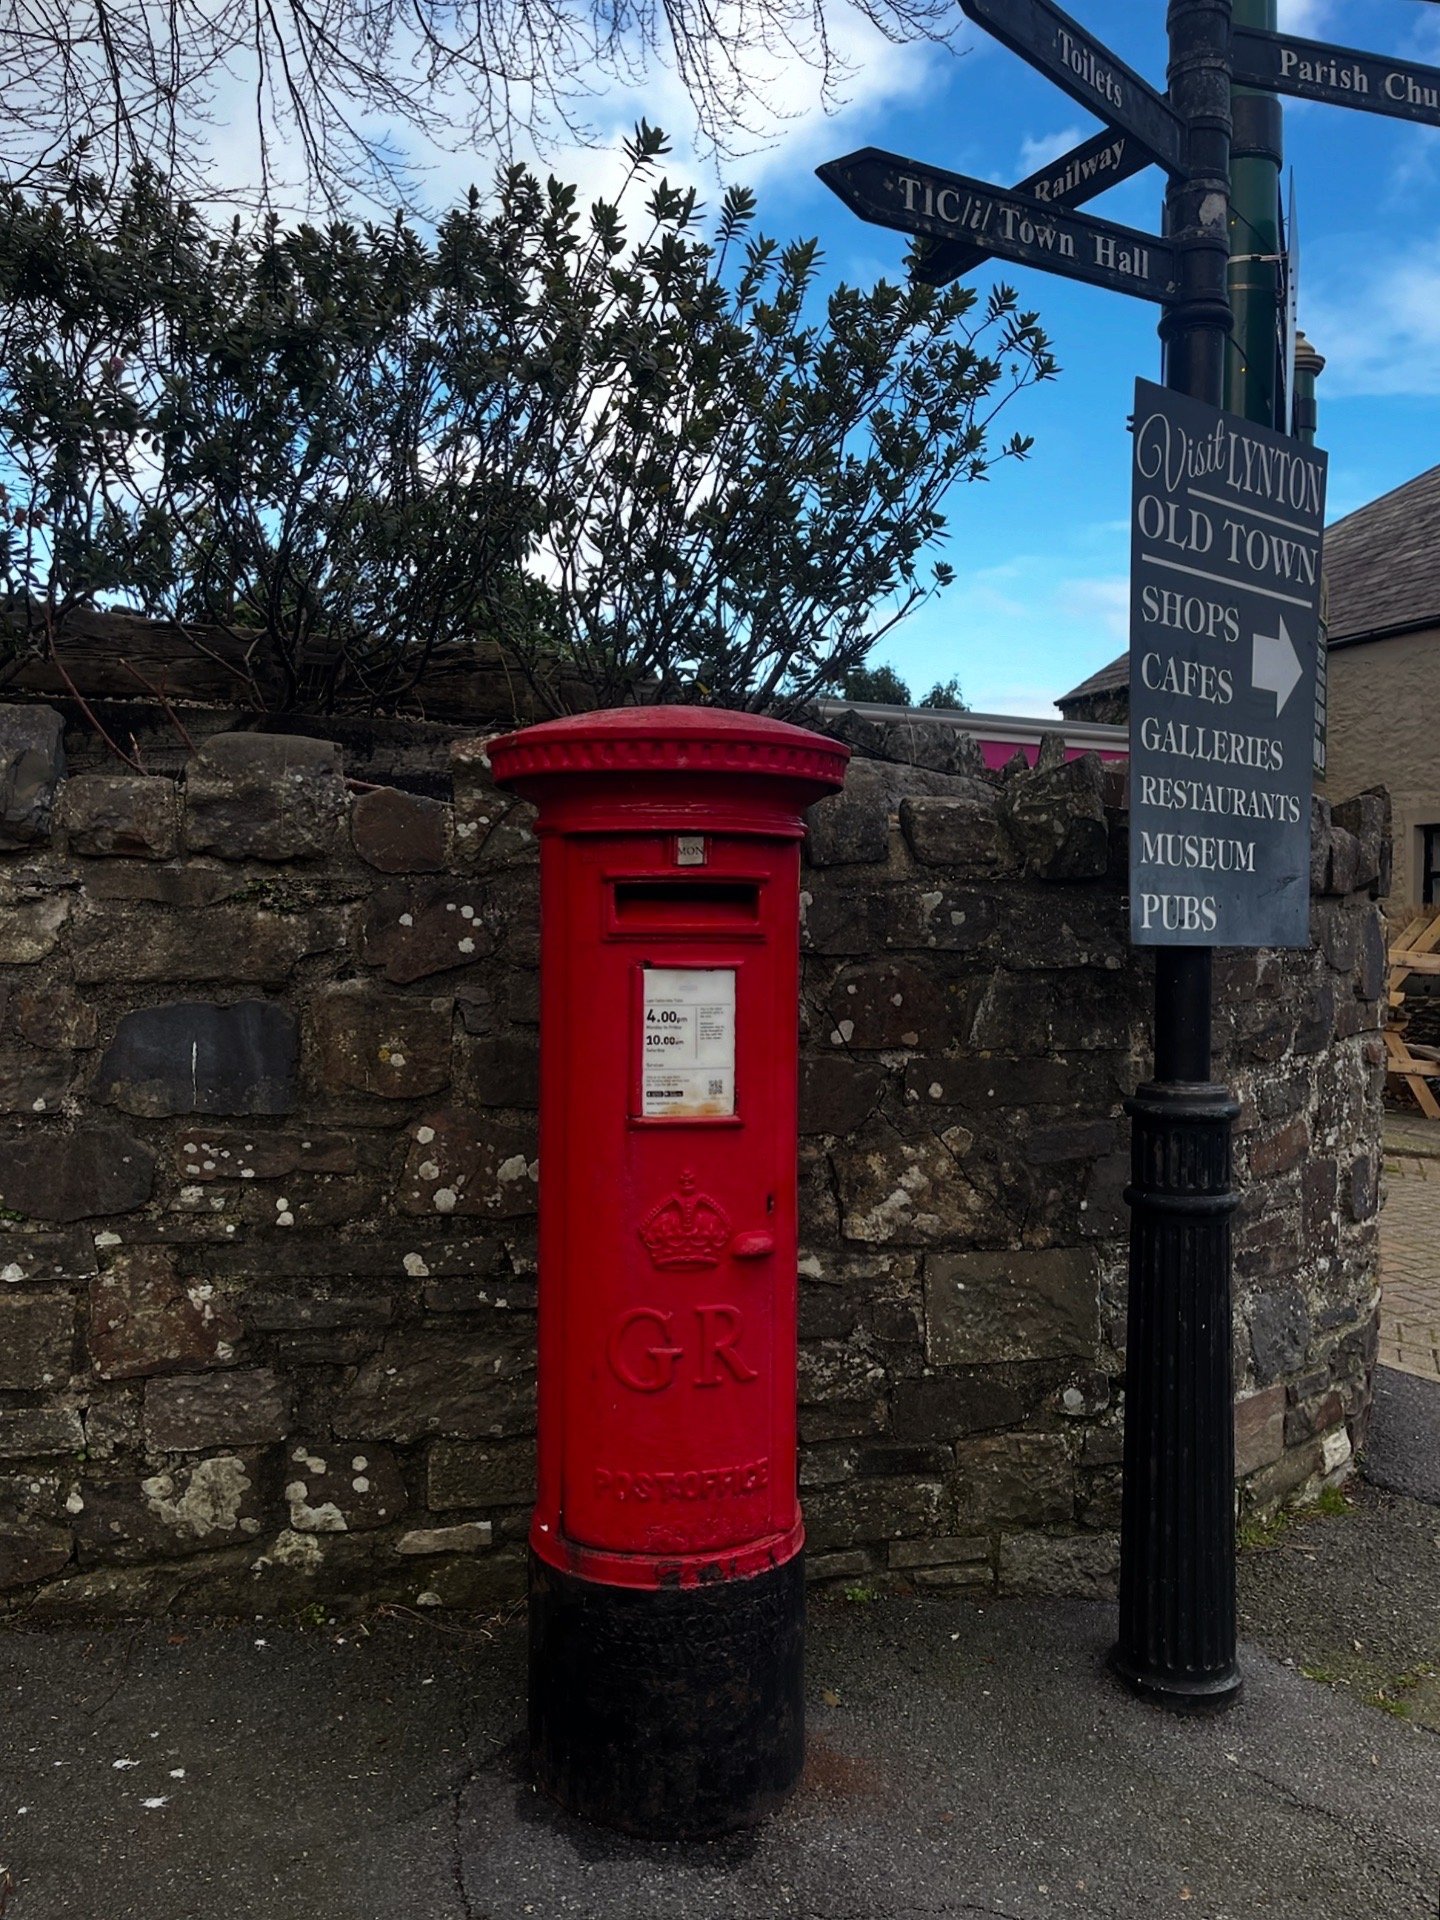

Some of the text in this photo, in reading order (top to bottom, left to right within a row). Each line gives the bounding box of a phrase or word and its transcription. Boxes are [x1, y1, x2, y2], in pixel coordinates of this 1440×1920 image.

[1056, 29, 1123, 109] Toilets
[1278, 49, 1369, 94] Parish
[1034, 138, 1127, 202] Railway
[998, 206, 1076, 258] Town
[1093, 235, 1150, 280] Hall
[1136, 413, 1324, 517] Visit LYNTON
[1137, 494, 1319, 587] OLD TOWN
[1141, 584, 1240, 643] SHOPS
[1140, 651, 1234, 705] CAFES
[1140, 716, 1284, 772] GALLERIES
[1139, 775, 1301, 824] RESTAURANTS
[1139, 831, 1256, 872] MUSEUM
[1139, 892, 1218, 932] PUBS
